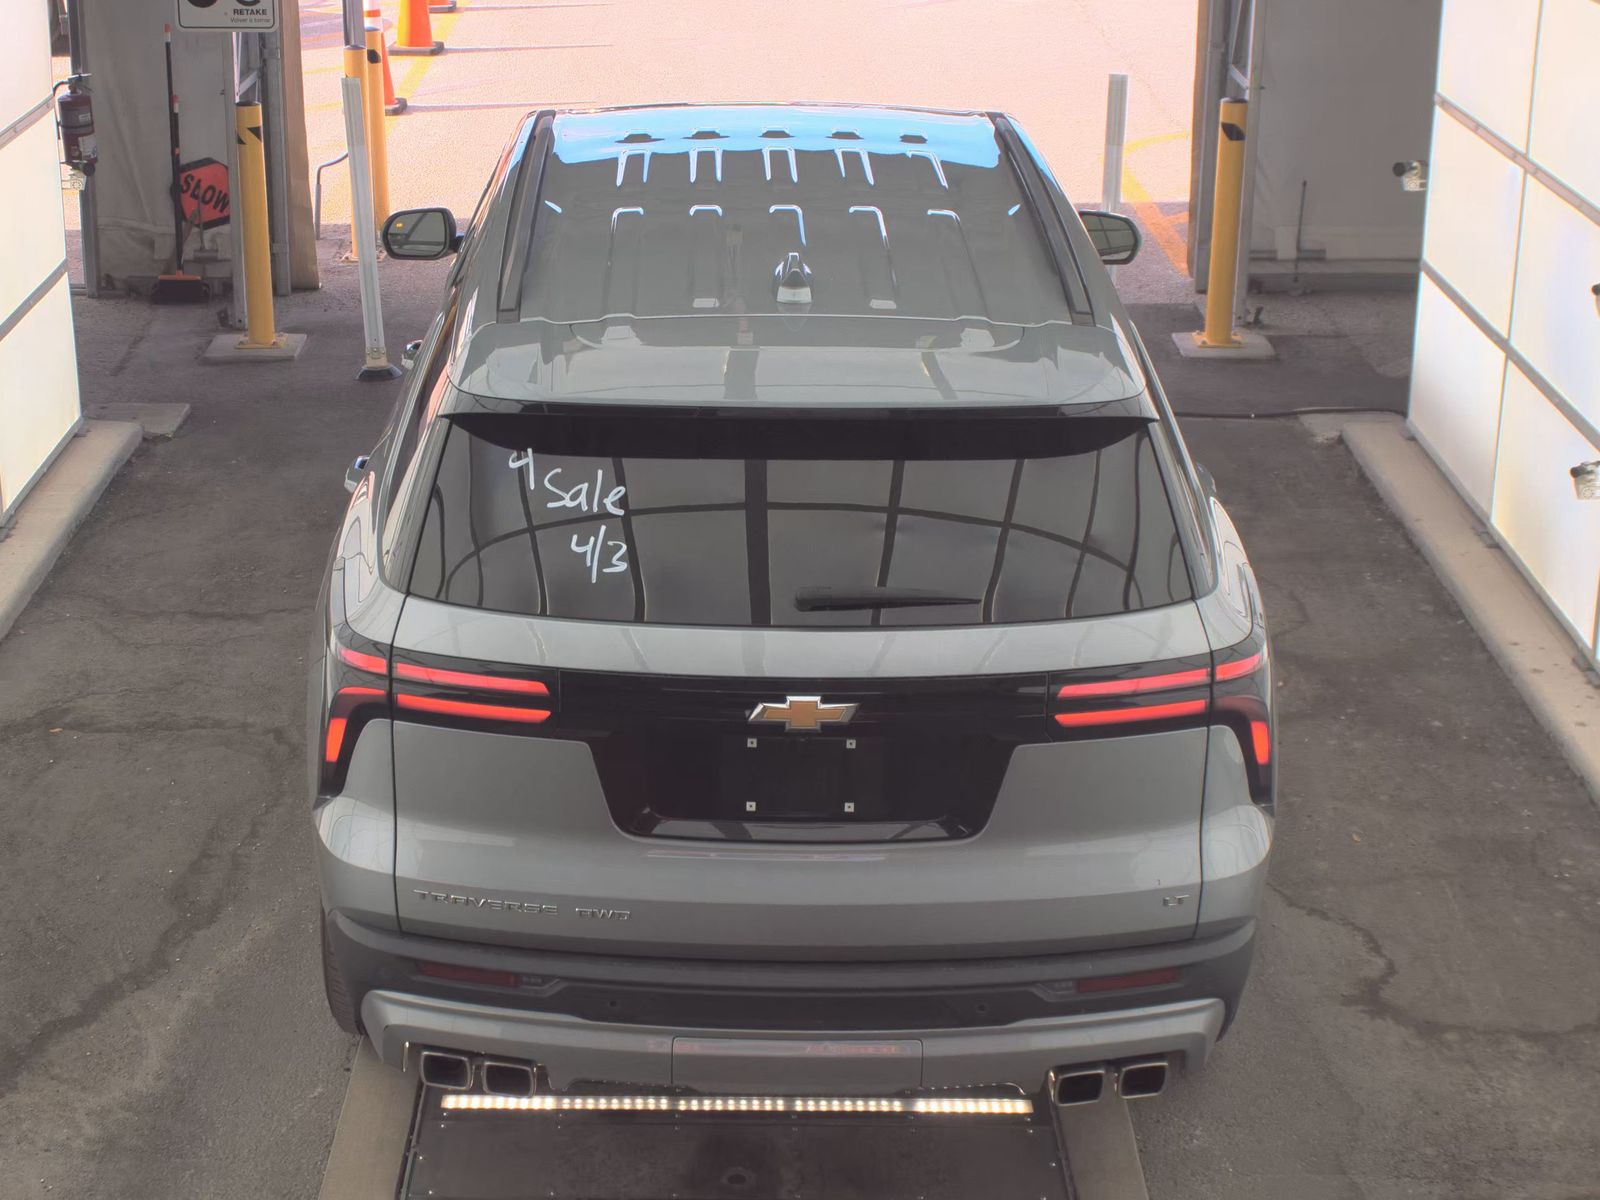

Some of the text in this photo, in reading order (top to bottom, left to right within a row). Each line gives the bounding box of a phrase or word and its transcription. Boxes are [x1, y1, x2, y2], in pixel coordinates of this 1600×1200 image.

[181, 173, 229, 213] SLOW
[544, 467, 626, 515] Sale
[570, 525, 628, 583] 4/3
[413, 889, 631, 921] TRAVERSE AWD
[1162, 894, 1190, 907] LT
